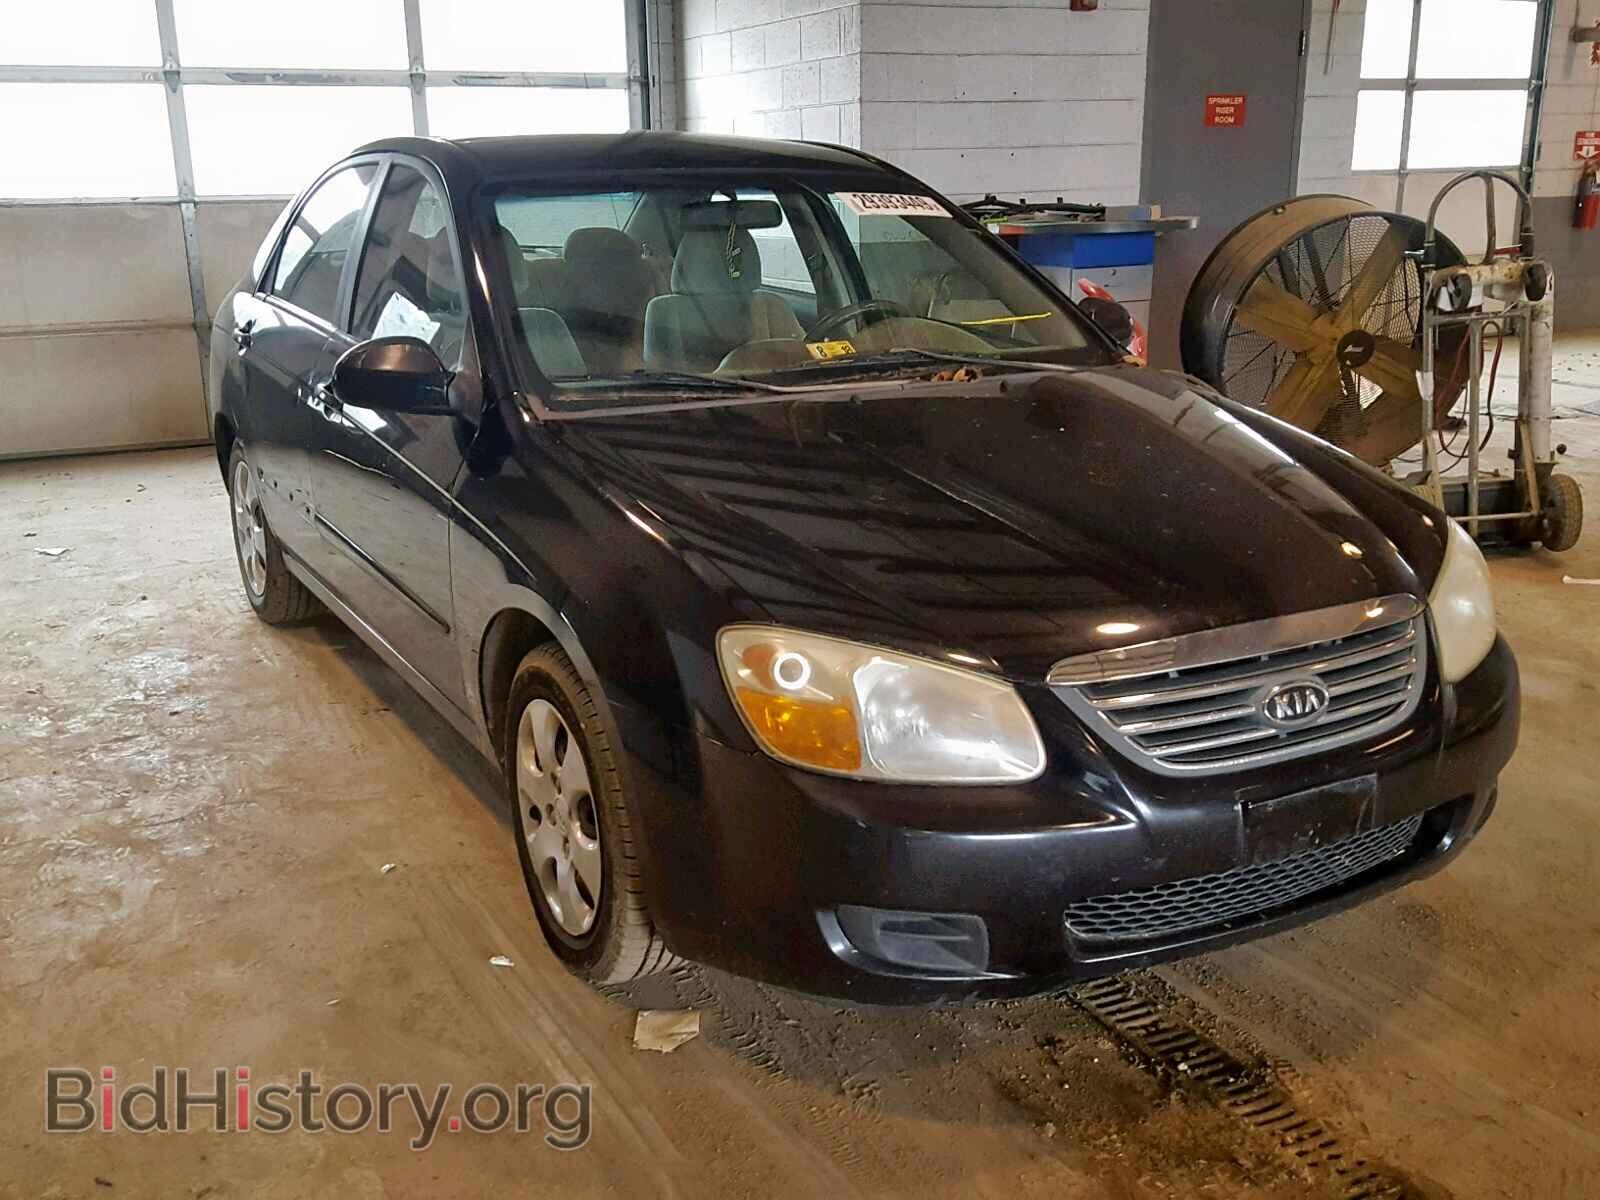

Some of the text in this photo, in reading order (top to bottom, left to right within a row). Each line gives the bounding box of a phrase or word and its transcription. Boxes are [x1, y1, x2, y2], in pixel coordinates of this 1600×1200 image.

[1208, 96, 1244, 105] SPRINKLER
[1214, 115, 1235, 124] ROOM
[1273, 687, 1321, 719] KIA
